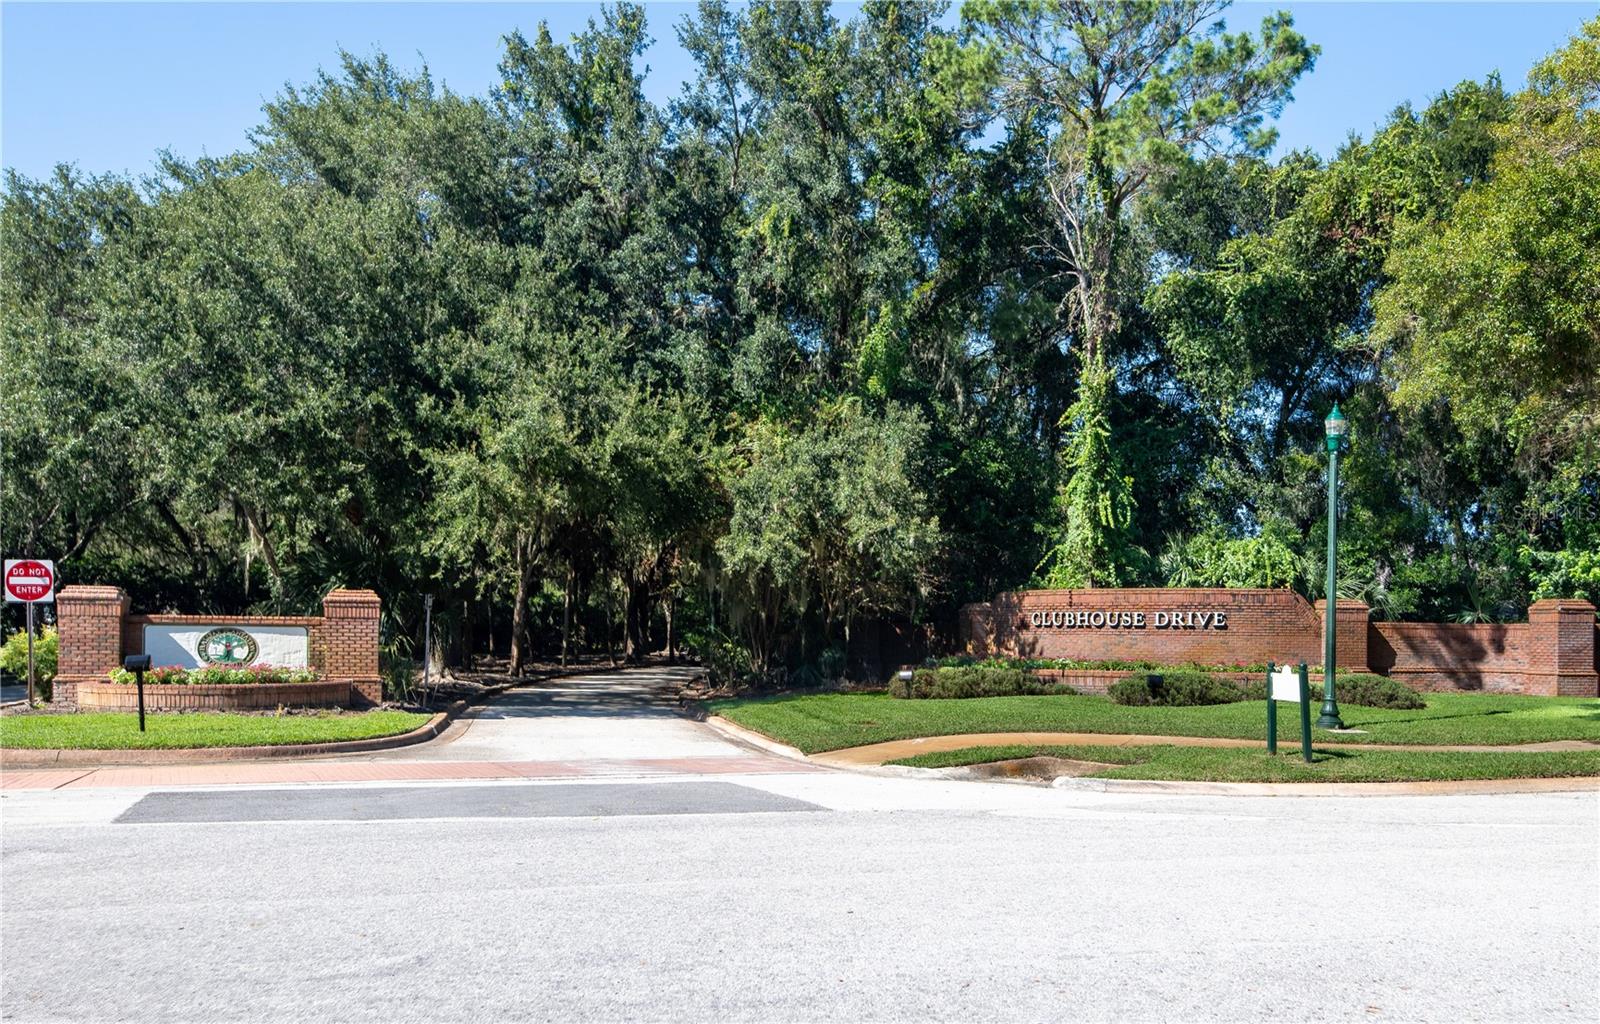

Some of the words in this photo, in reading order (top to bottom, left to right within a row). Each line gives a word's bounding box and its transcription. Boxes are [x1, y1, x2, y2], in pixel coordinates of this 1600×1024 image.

[12, 568, 25, 576] DO
[29, 568, 46, 576] NOT
[16, 586, 43, 594] ENTER
[1031, 611, 1145, 627] CLUBHOUSE
[1154, 611, 1227, 628] DRIVE
